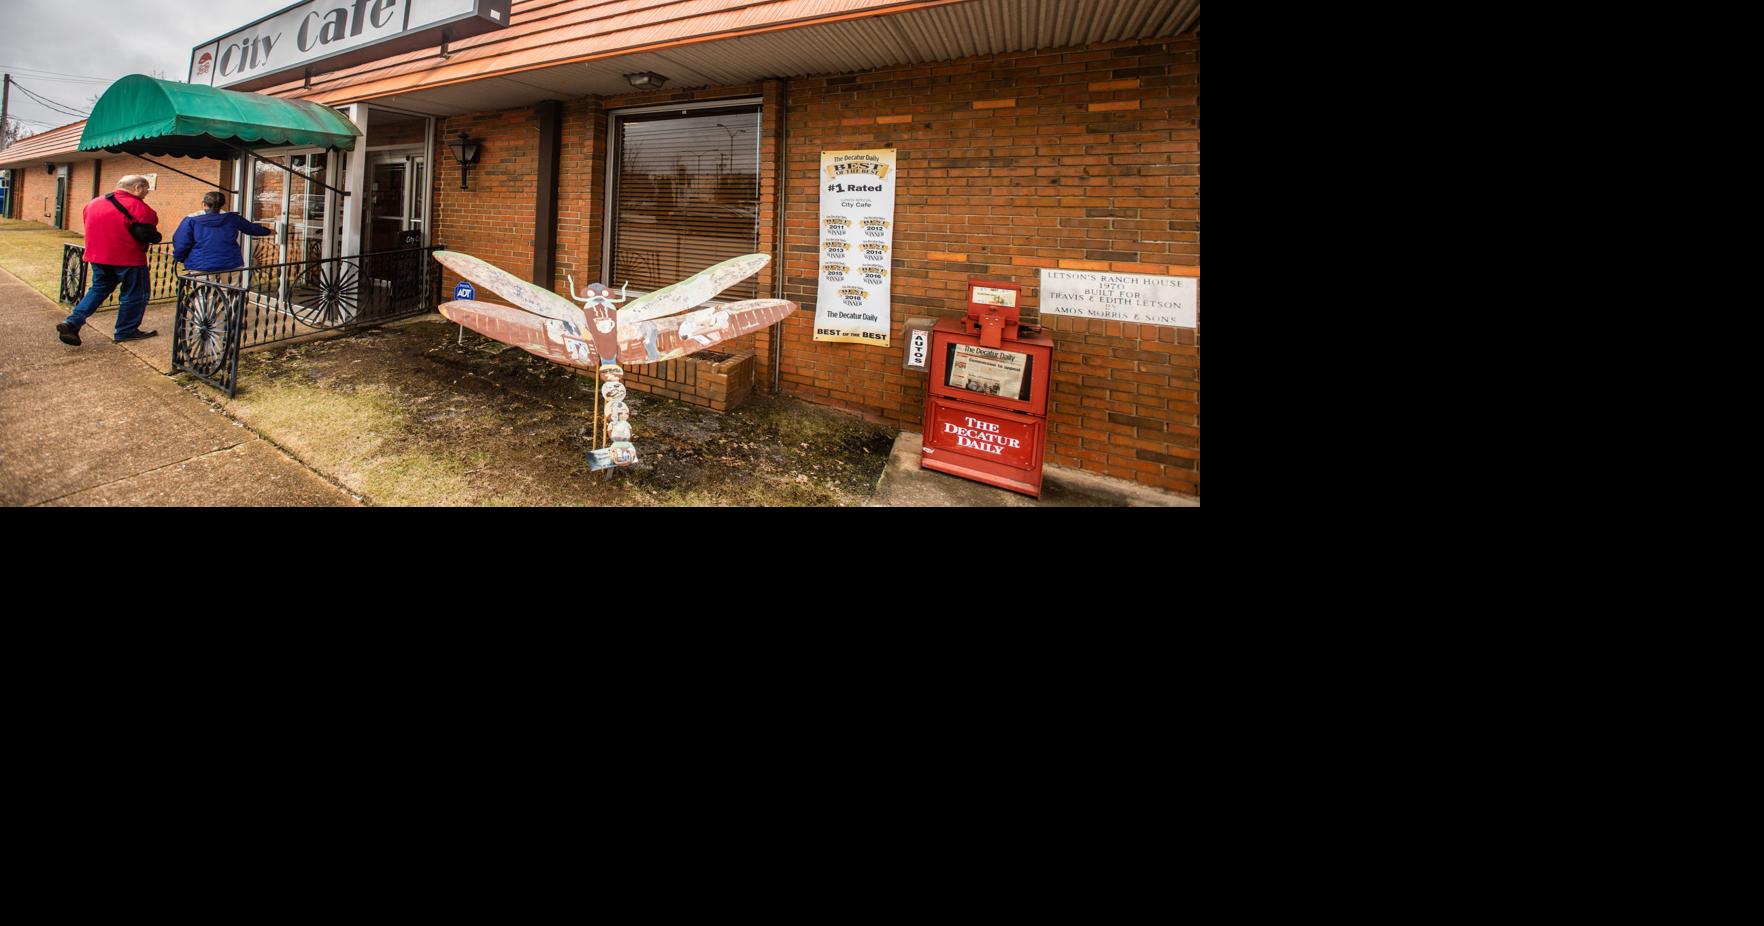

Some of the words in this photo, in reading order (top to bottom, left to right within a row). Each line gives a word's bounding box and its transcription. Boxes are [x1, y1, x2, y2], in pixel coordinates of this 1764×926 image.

[220, 32, 282, 77] City
[828, 184, 845, 193] #1
[848, 184, 882, 192] Rated
[1048, 272, 1096, 281] LETSON'S
[1101, 275, 1138, 285] RANCH
[1143, 278, 1184, 287] HOUSE
[457, 288, 471, 298] ADT
[1084, 289, 1114, 297] BUILT
[1050, 292, 1084, 301] TRAVIS
[1100, 297, 1132, 305] EDITH
[1136, 300, 1182, 309] LETSON
[862, 313, 878, 322] Daily
[1088, 310, 1128, 319] MORRIS
[1145, 315, 1176, 323] SONS
[863, 332, 886, 340] BEST
[914, 336, 923, 363] AUTOS
[976, 348, 999, 358] Decatur
[1000, 352, 1016, 362] Daily
[965, 417, 1000, 433] THE
[944, 423, 1020, 448] DECATUR
[957, 436, 1004, 455] DAILY
